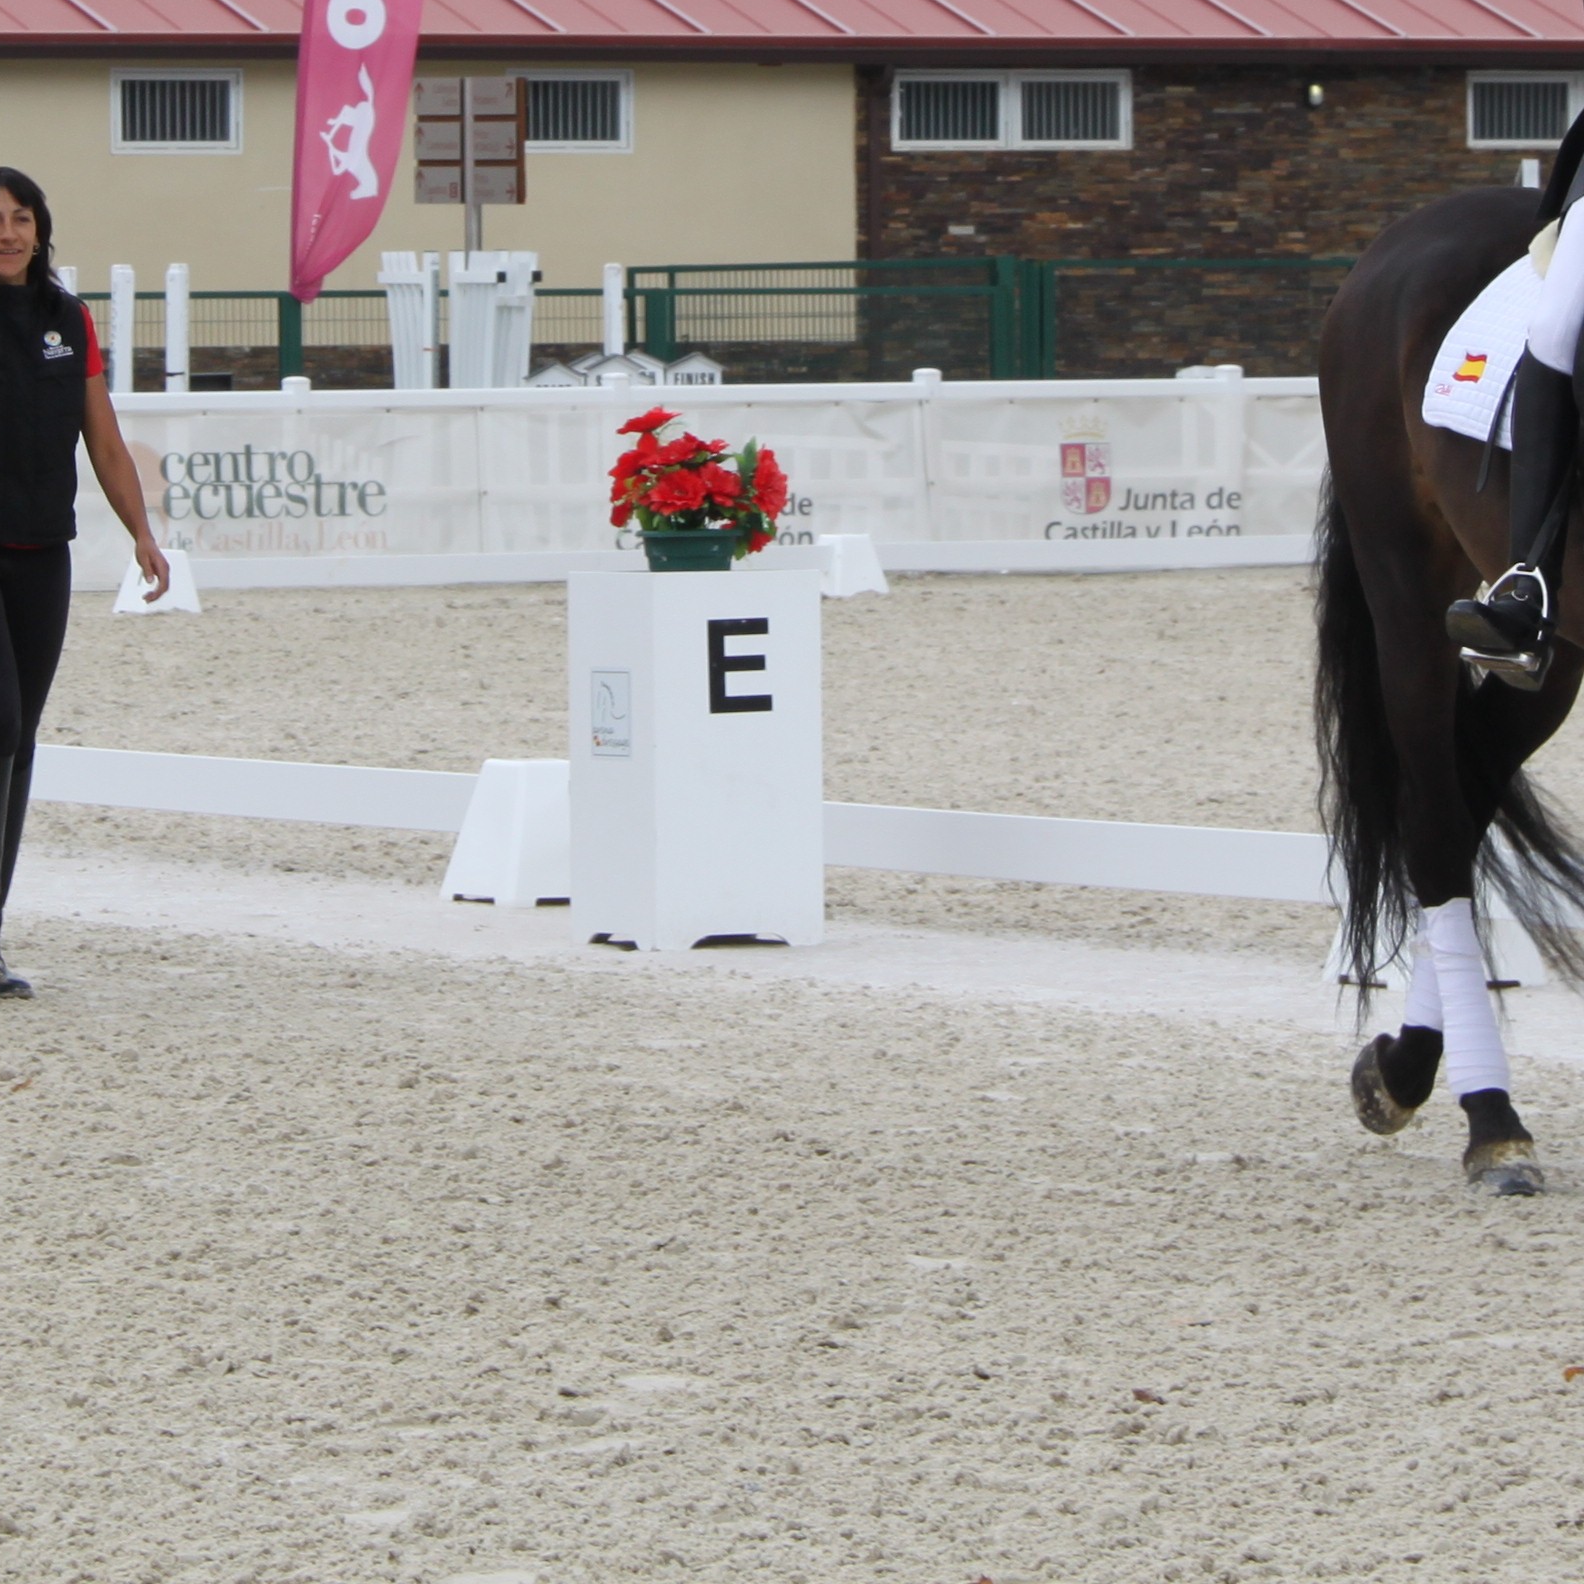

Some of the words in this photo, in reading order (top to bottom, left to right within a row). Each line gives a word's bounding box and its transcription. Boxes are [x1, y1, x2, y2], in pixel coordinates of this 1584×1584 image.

[160, 444, 315, 485] centro
[162, 472, 387, 521] ecuestre
[1118, 487, 1195, 511] Junta
[1205, 487, 1241, 510] de
[1044, 520, 1137, 540] Castilla
[707, 617, 773, 714] E
